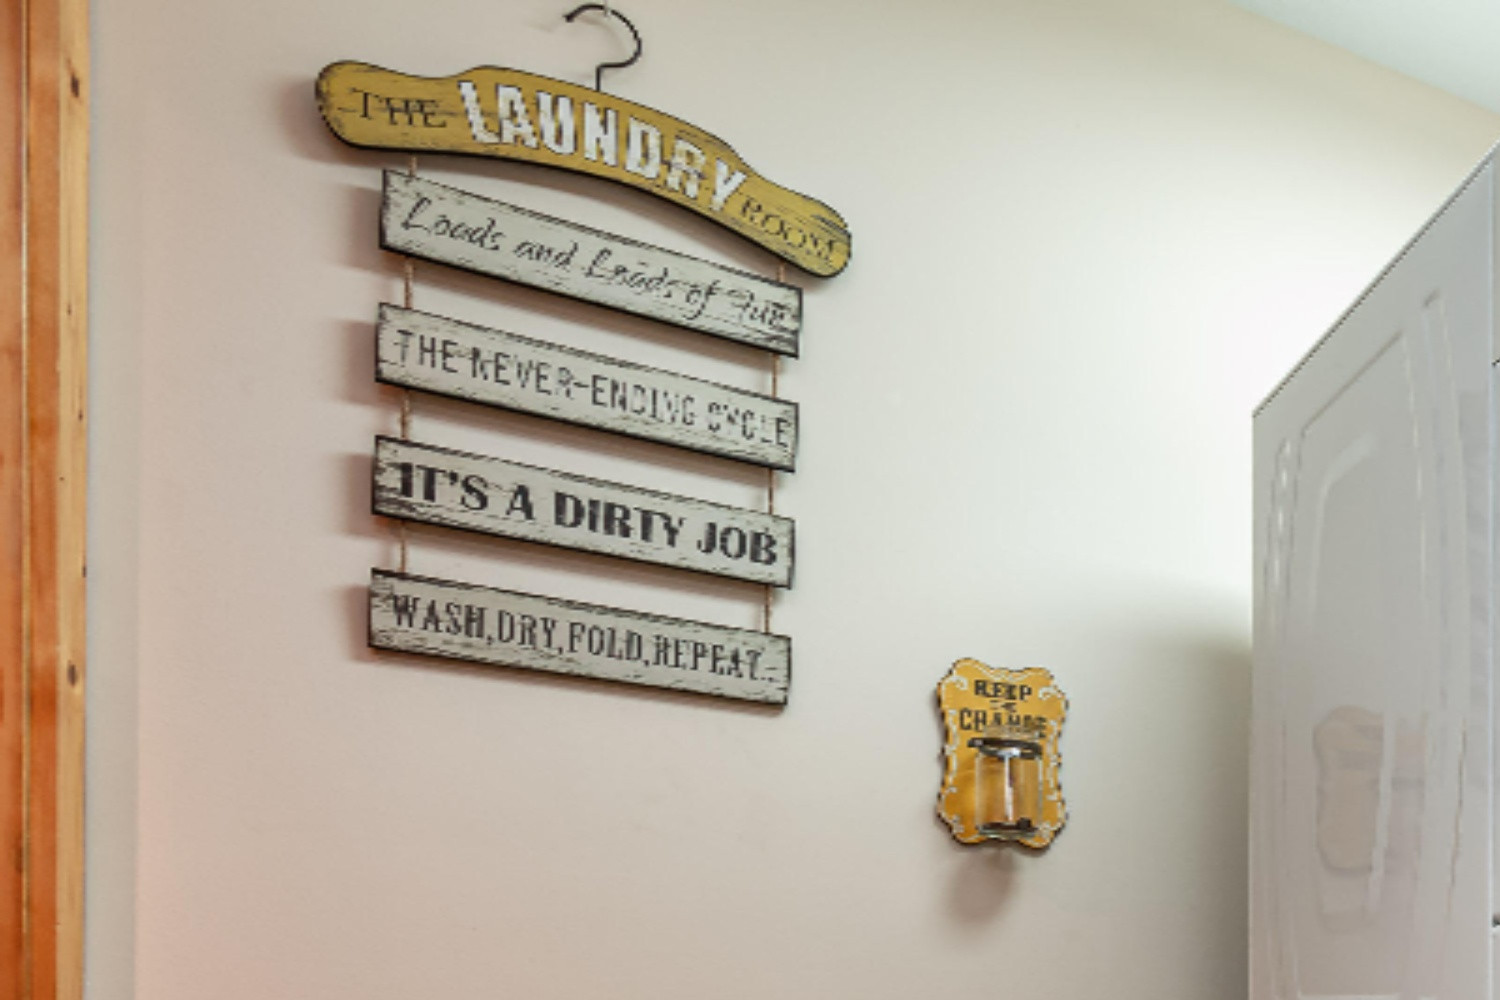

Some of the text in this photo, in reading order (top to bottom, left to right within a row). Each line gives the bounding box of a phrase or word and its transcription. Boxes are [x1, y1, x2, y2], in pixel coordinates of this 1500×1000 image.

[350, 80, 836, 268] THE LAUNDRY ROOM
[400, 197, 504, 251] Loads
[513, 241, 579, 271] and
[585, 248, 674, 299] Loads
[684, 279, 718, 321] of
[396, 329, 789, 448] THE NEVER-ENDING CYCLE
[388, 461, 778, 566] IT'S A DIRTY JOB
